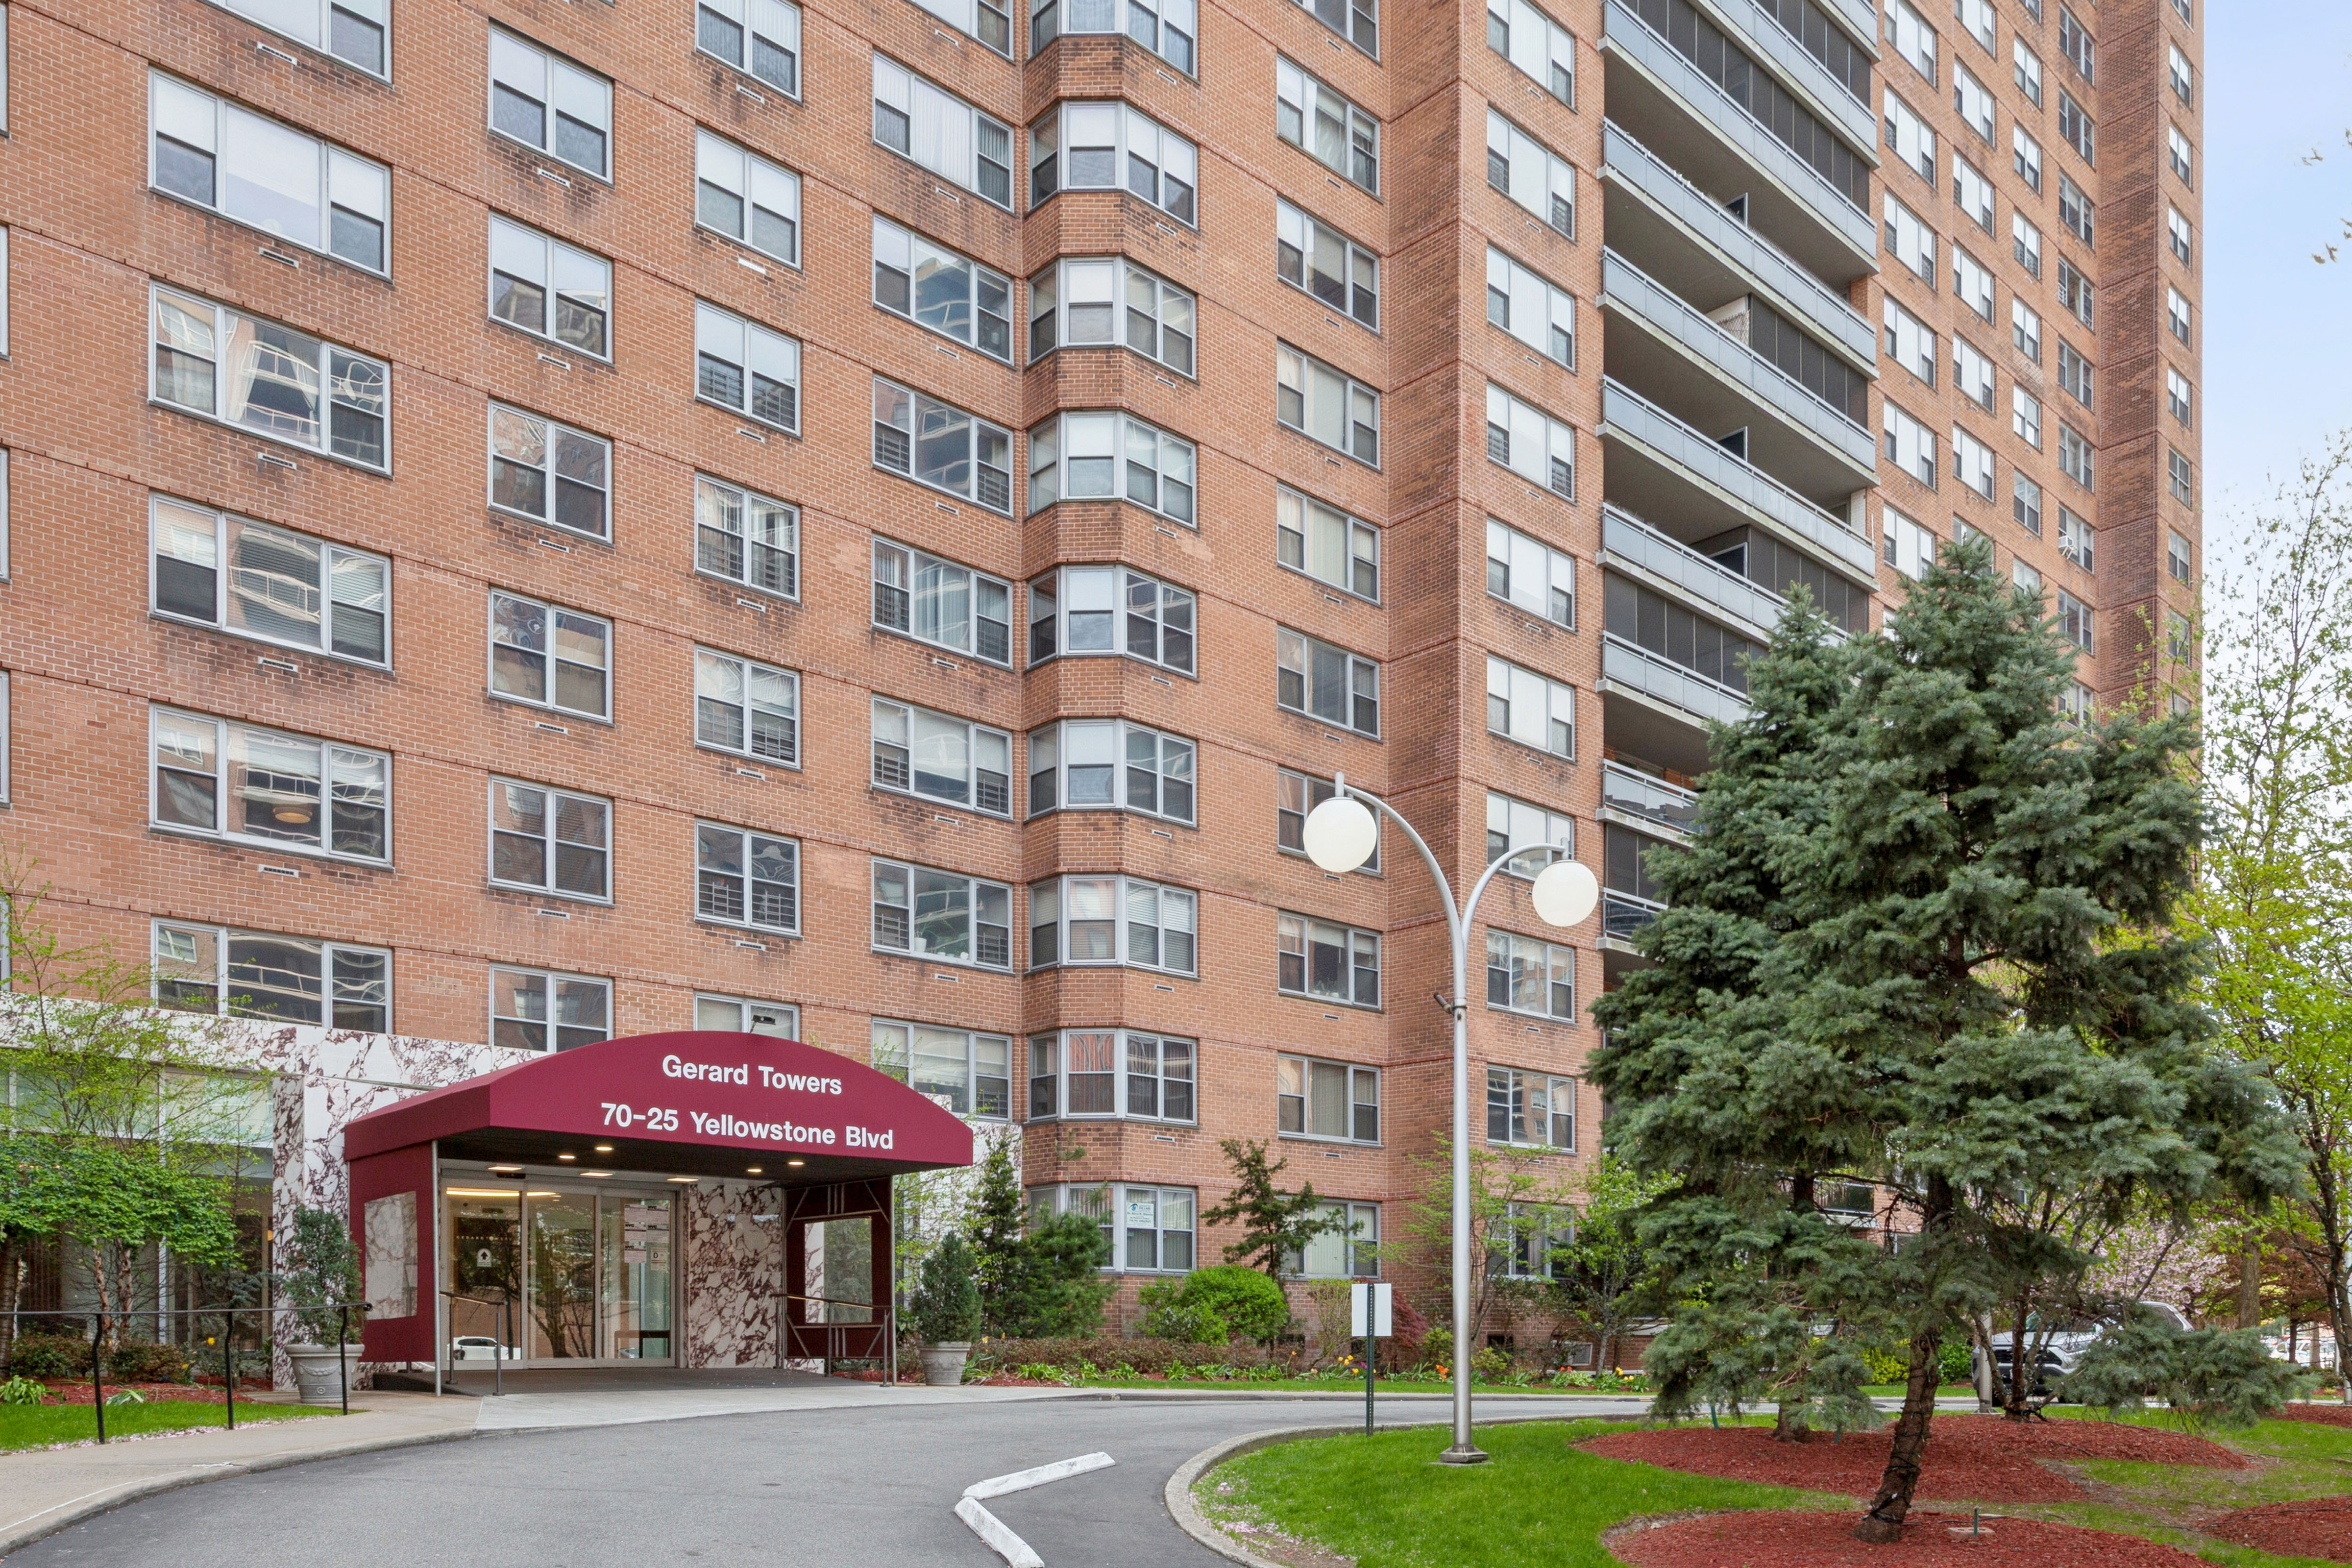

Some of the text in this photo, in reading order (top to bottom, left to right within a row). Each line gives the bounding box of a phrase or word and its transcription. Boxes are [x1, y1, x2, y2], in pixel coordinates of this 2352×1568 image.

[662, 1054, 842, 1095] Gerard Towers
[601, 1102, 893, 1150] 70-25 Yellowstone Blvd
